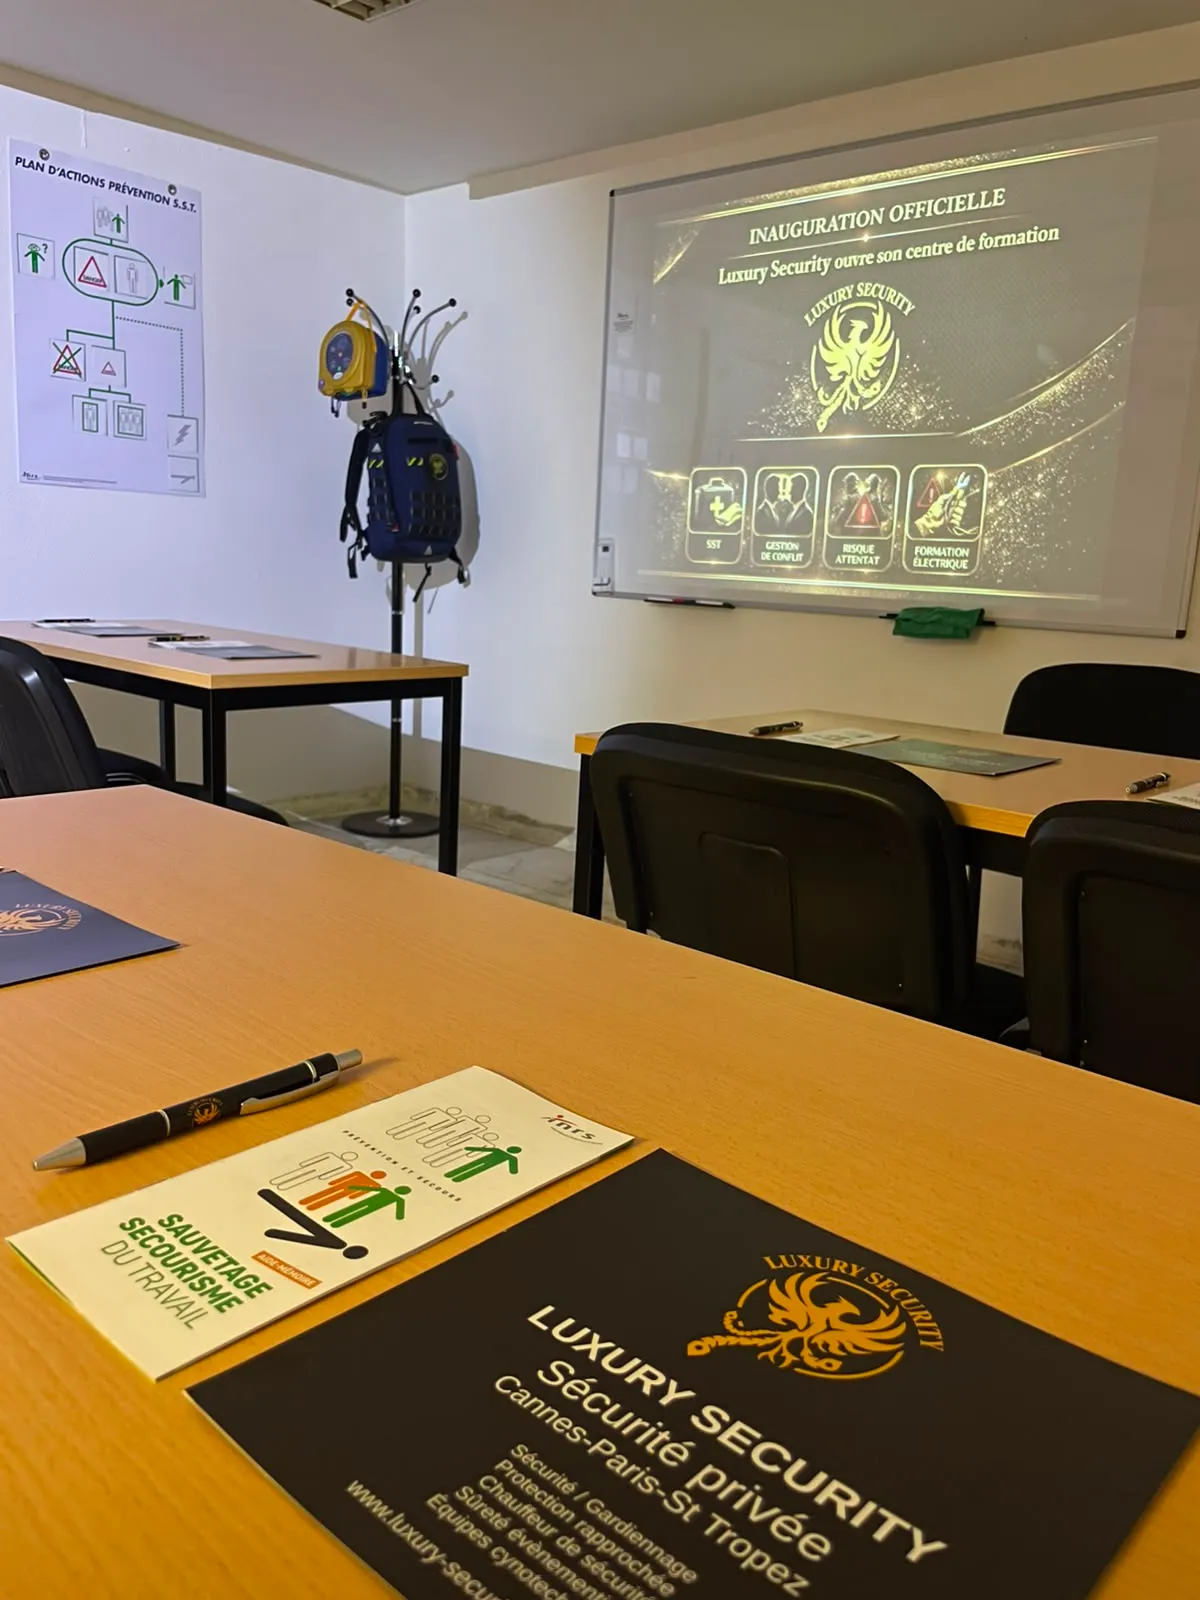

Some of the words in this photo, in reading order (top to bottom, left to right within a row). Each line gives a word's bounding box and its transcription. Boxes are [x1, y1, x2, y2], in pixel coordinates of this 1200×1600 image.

[15, 156, 45, 173] PLAN
[48, 165, 105, 188] D'ACTIONS
[108, 181, 170, 206] PRÉVENTION
[172, 198, 197, 213] S.S.T.
[749, 207, 885, 245] INAUGURATION
[888, 187, 1006, 223] OFFICIELLE
[718, 264, 768, 286] Luxury
[769, 255, 832, 279] Security
[834, 252, 874, 270] ouvre
[877, 249, 902, 264] son
[905, 242, 953, 259] centre
[956, 235, 976, 252] de
[978, 225, 1060, 250] formation
[803, 284, 854, 327] LUXURY
[855, 281, 916, 316] SECURITY
[706, 539, 722, 549] SST
[761, 552, 772, 561] DE
[772, 552, 804, 562] CONFLIT
[765, 541, 799, 551] GESTION
[835, 554, 880, 566] ATTENTAT
[842, 544, 875, 556] RISQUE
[913, 556, 969, 570] ÉLECTRIQUE
[914, 545, 970, 558] FORMATION
[342, 1129, 398, 1165] PRÉVENTION
[401, 1166, 414, 1175] ET
[417, 1176, 462, 1202] SECOURS
[101, 1239, 142, 1266] DU
[128, 1261, 209, 1330] TRAVAIL
[119, 1217, 244, 1313] SECOURISME
[158, 1213, 273, 1299] SAUVETAGE
[762, 1254, 866, 1278] LUXURY
[864, 1271, 944, 1352] SECURITY
[527, 1304, 696, 1408] LUXURY
[691, 1404, 948, 1565] SECURITY
[536, 1359, 692, 1468] Sécurité
[684, 1461, 834, 1563] privée
[426, 1492, 494, 1550] Équipes
[494, 1374, 701, 1524] Cannes-Paris-St
[704, 1512, 810, 1597] Tropez
[511, 1443, 581, 1495] Sécurité
[585, 1498, 698, 1585] Gardiennage
[346, 1479, 508, 1600] www.luxury-secu
[454, 1485, 510, 1531] Sûreté
[507, 1527, 611, 1600] évènement
[479, 1475, 559, 1538] Chauffeur
[556, 1532, 582, 1557] de
[580, 1553, 656, 1600] sécurit
[494, 1459, 576, 1524] Protection
[574, 1518, 676, 1597] rapprochée
